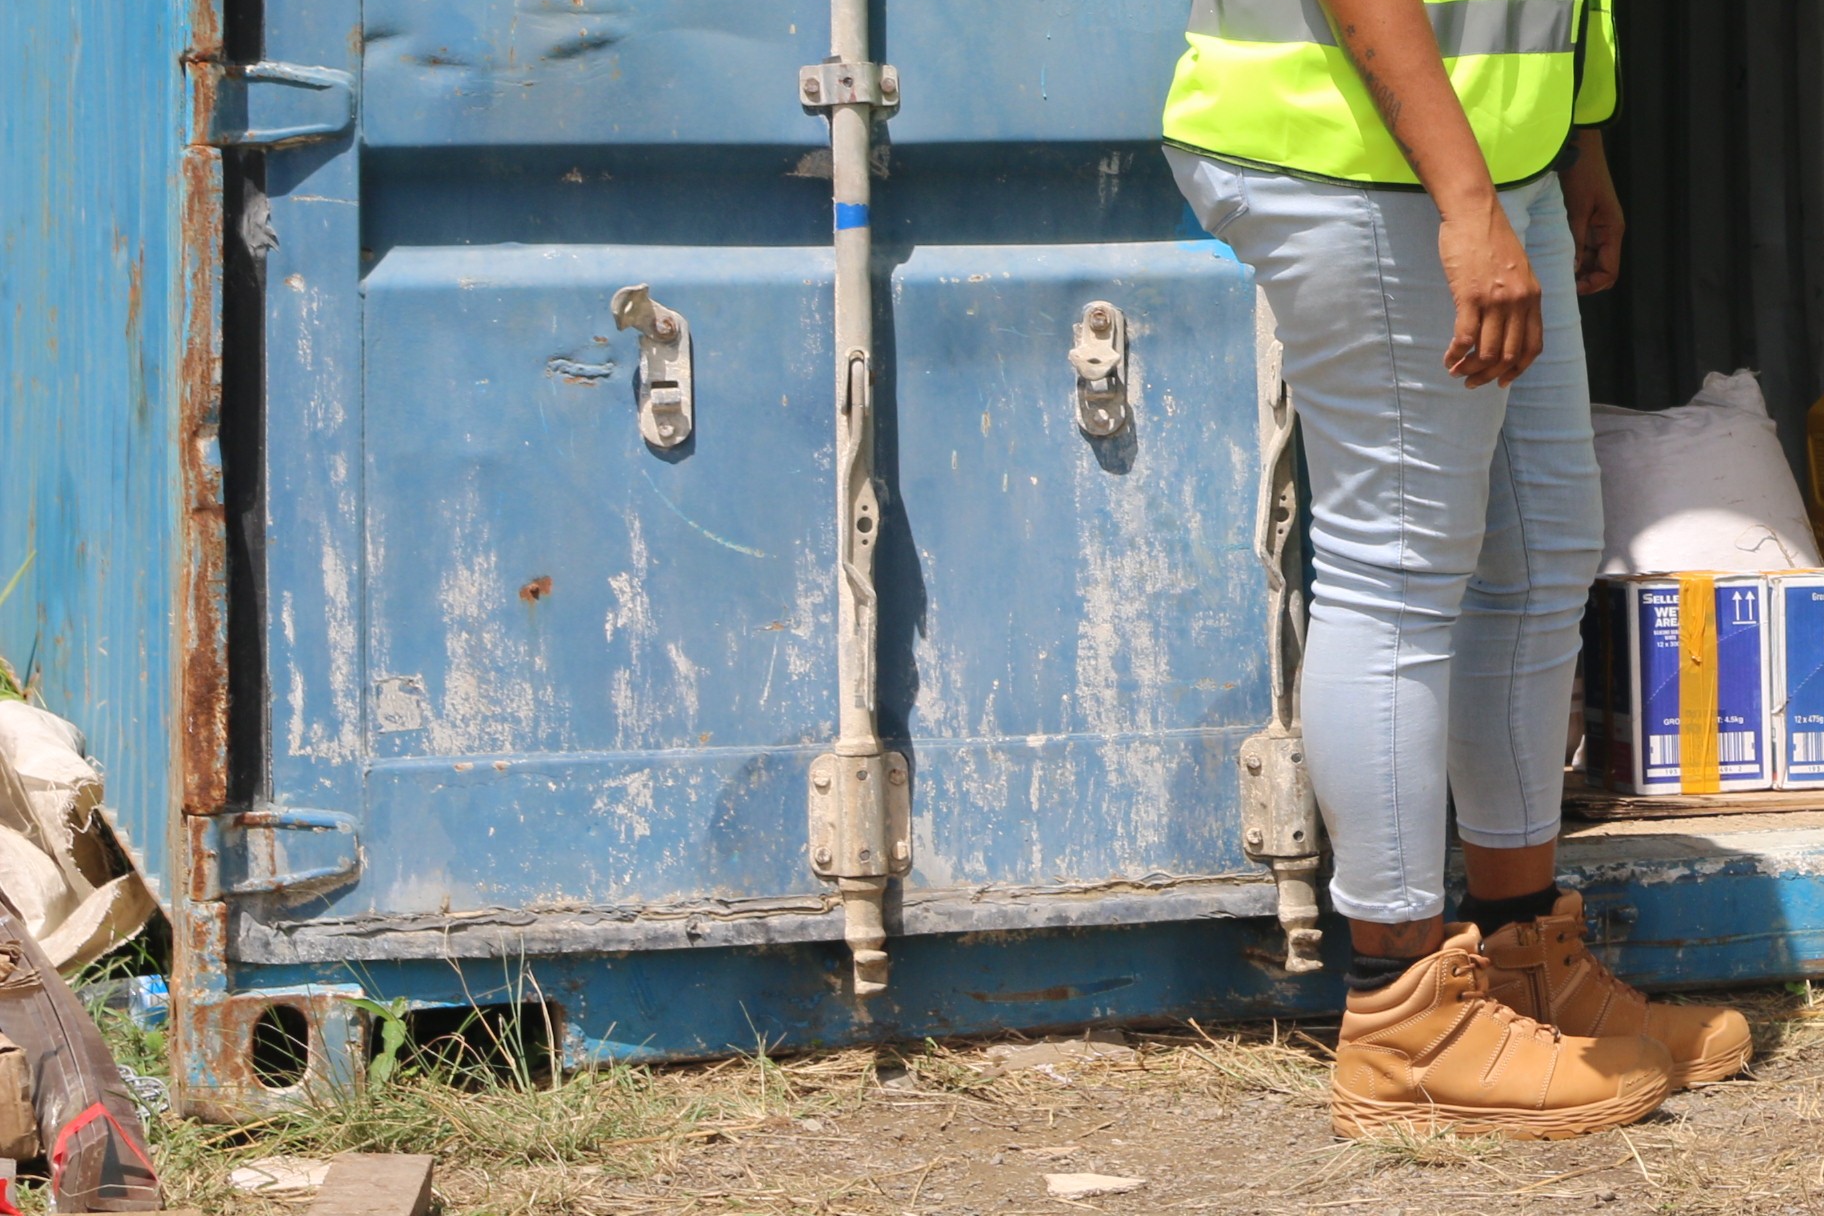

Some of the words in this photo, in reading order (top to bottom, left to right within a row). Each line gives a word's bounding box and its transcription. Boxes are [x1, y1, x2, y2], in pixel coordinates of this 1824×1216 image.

[1642, 593, 1680, 604] SELLE
[1654, 618, 1680, 628] ARE
[1663, 717, 1681, 725] GRO
[1794, 715, 1802, 724] 12
[1808, 714, 1824, 724] 475g
